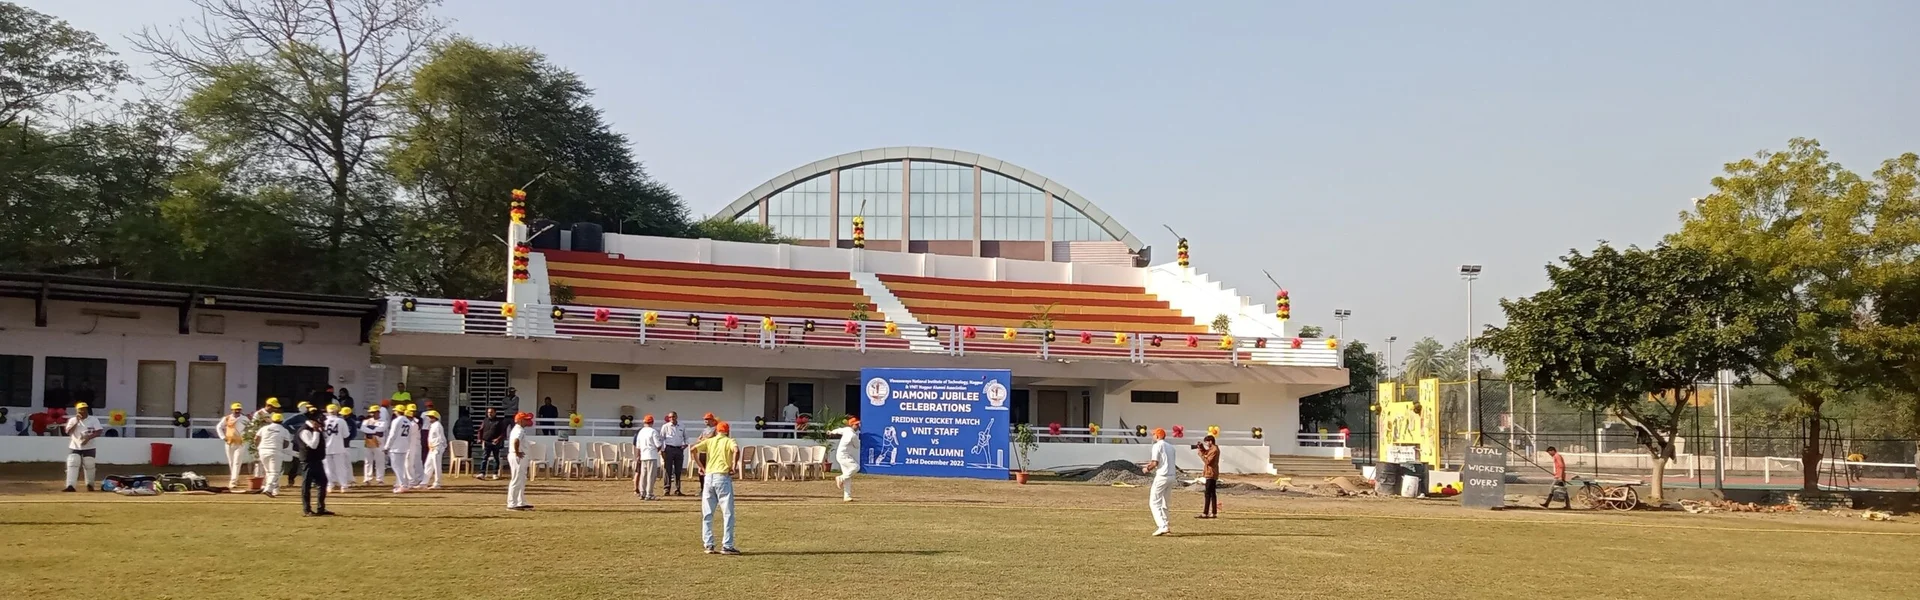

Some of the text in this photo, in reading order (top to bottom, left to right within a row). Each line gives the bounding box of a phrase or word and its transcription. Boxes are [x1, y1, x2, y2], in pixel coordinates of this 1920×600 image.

[892, 391, 979, 400] DIAMOND JUBILEE
[900, 402, 972, 412] CELEBRATIONS
[326, 424, 338, 436] 64
[401, 424, 410, 437] 23
[912, 427, 959, 436] VNIT STAFF
[929, 448, 964, 457] ALUMNI
[1470, 447, 1502, 455] TOTAL
[1468, 464, 1505, 473] WICKETS
[1470, 478, 1498, 486] OVERS
